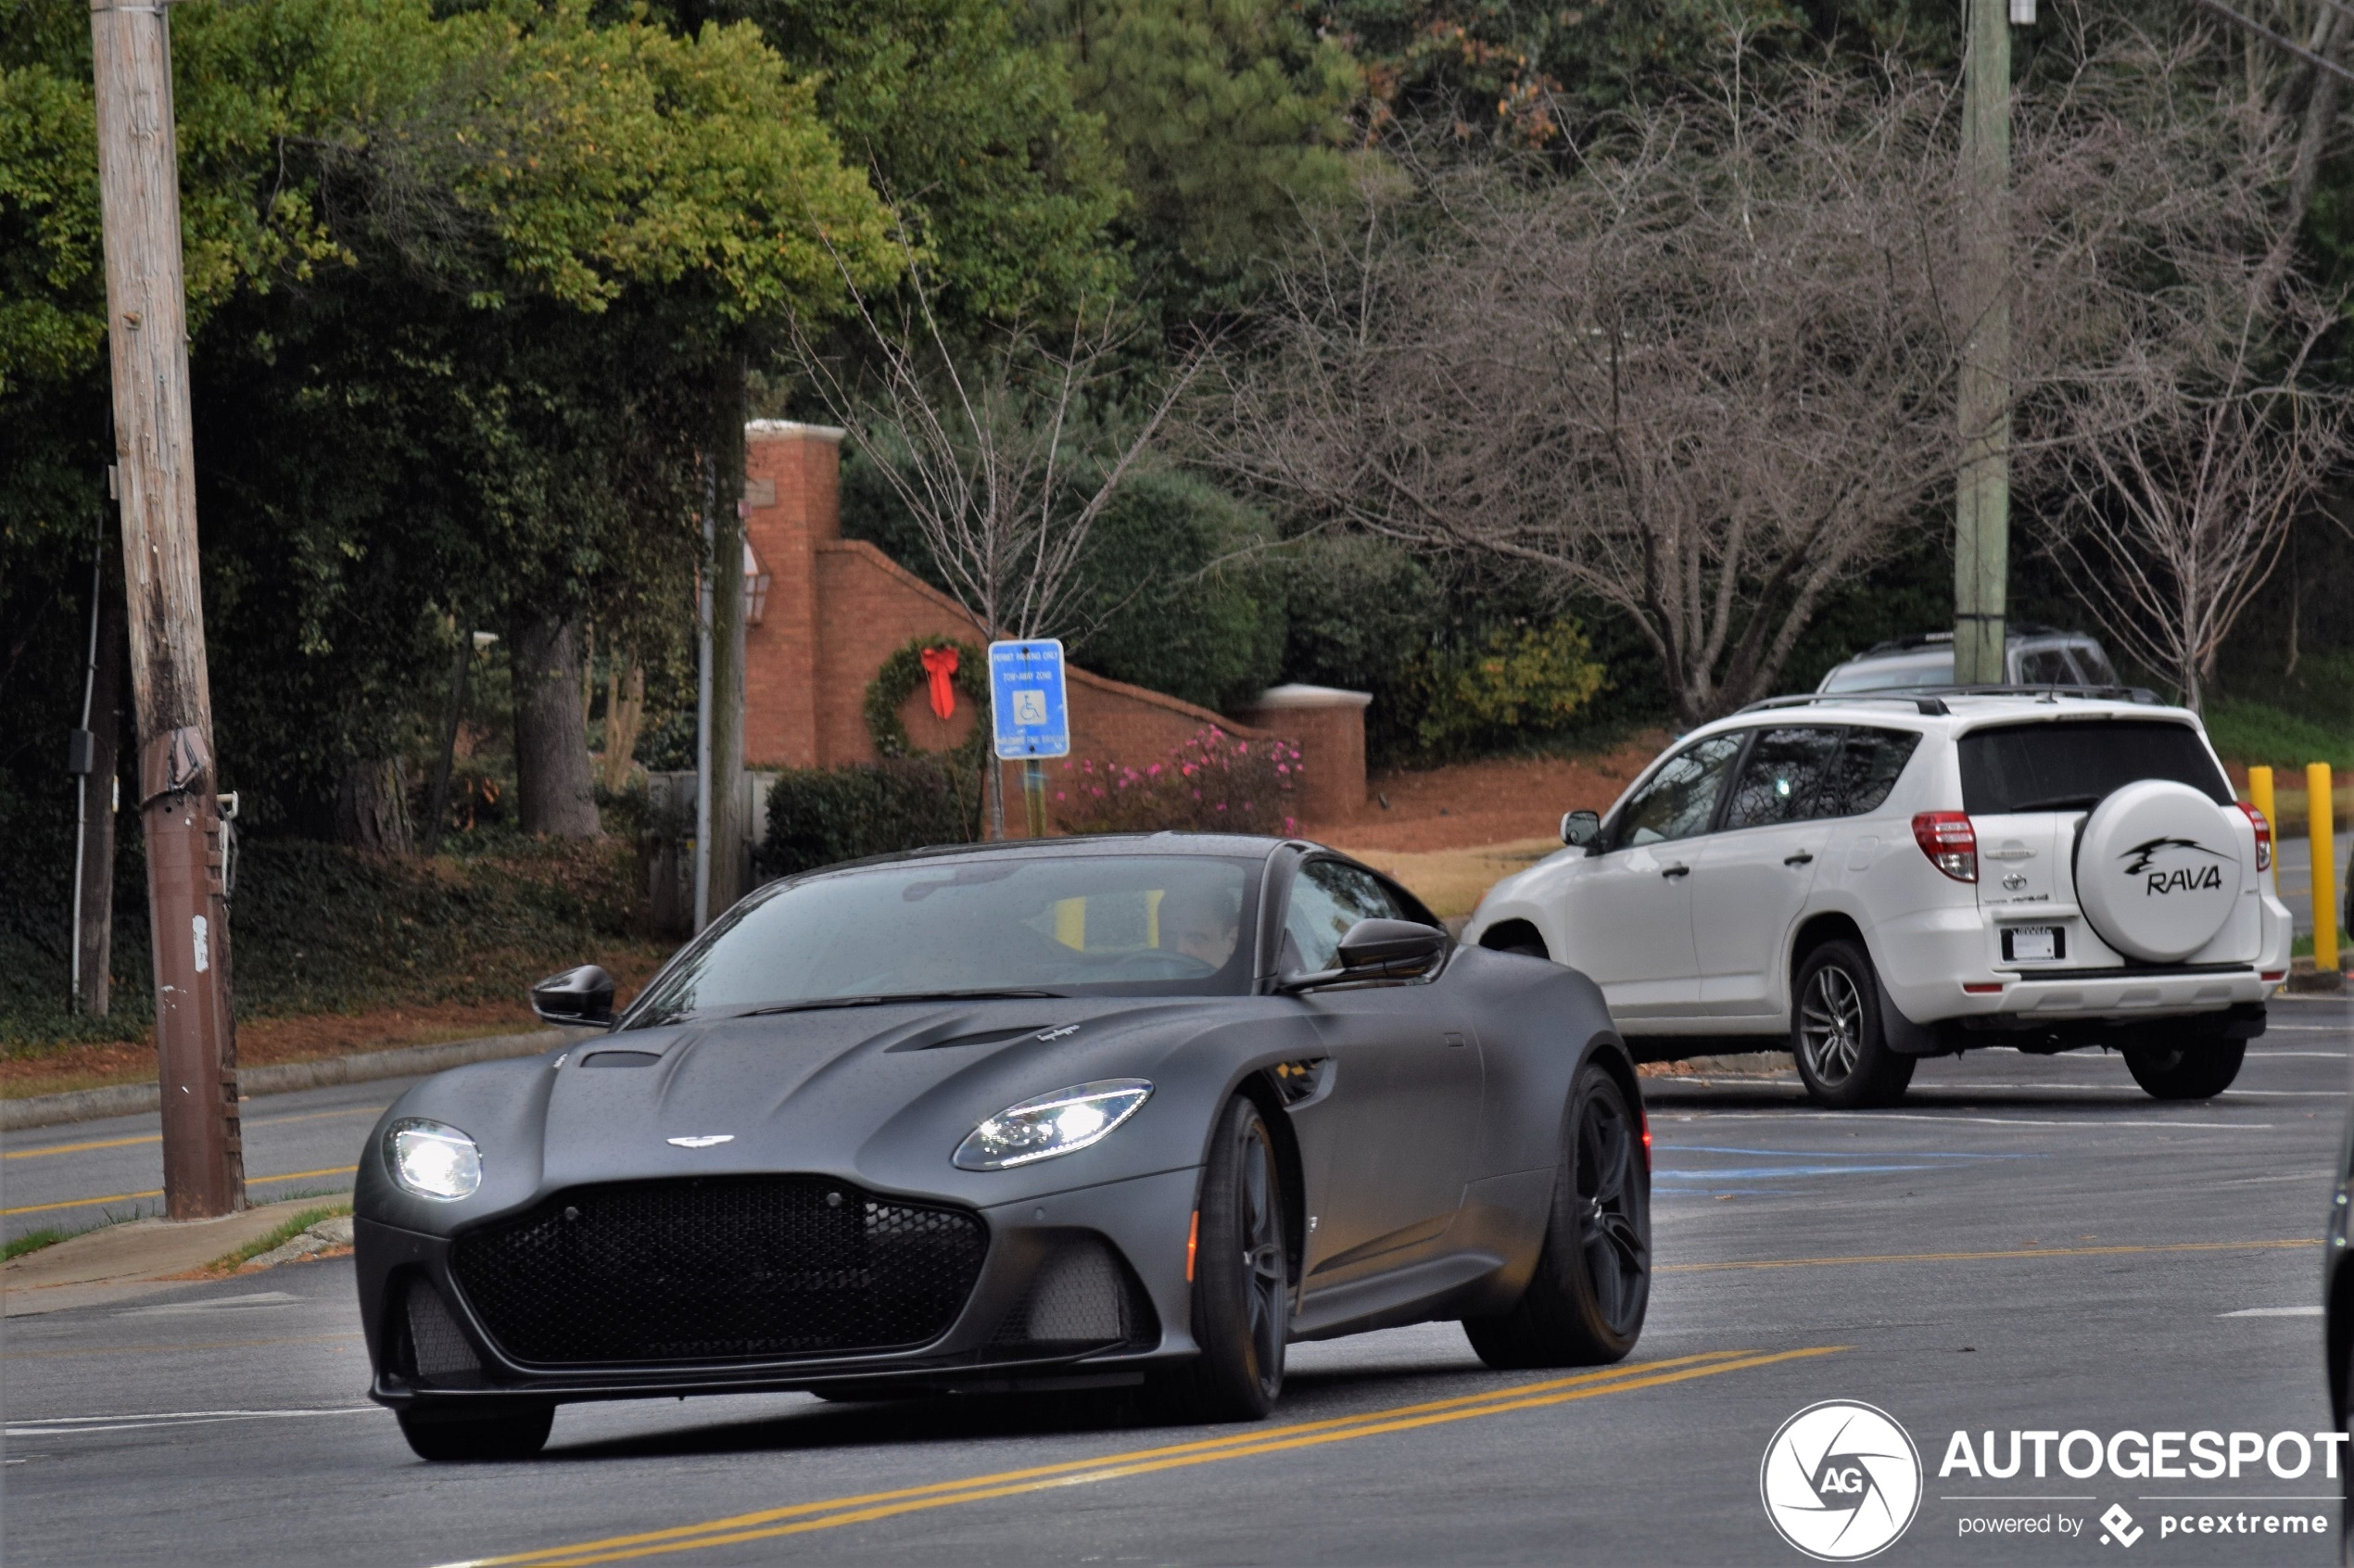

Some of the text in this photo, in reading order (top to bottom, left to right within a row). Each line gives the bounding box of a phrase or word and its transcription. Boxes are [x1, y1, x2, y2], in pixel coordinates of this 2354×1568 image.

[1043, 651, 1058, 661] ONLY
[1004, 671, 1052, 681] TOW-AWAY ZONE
[2146, 865, 2222, 896] RAV4
